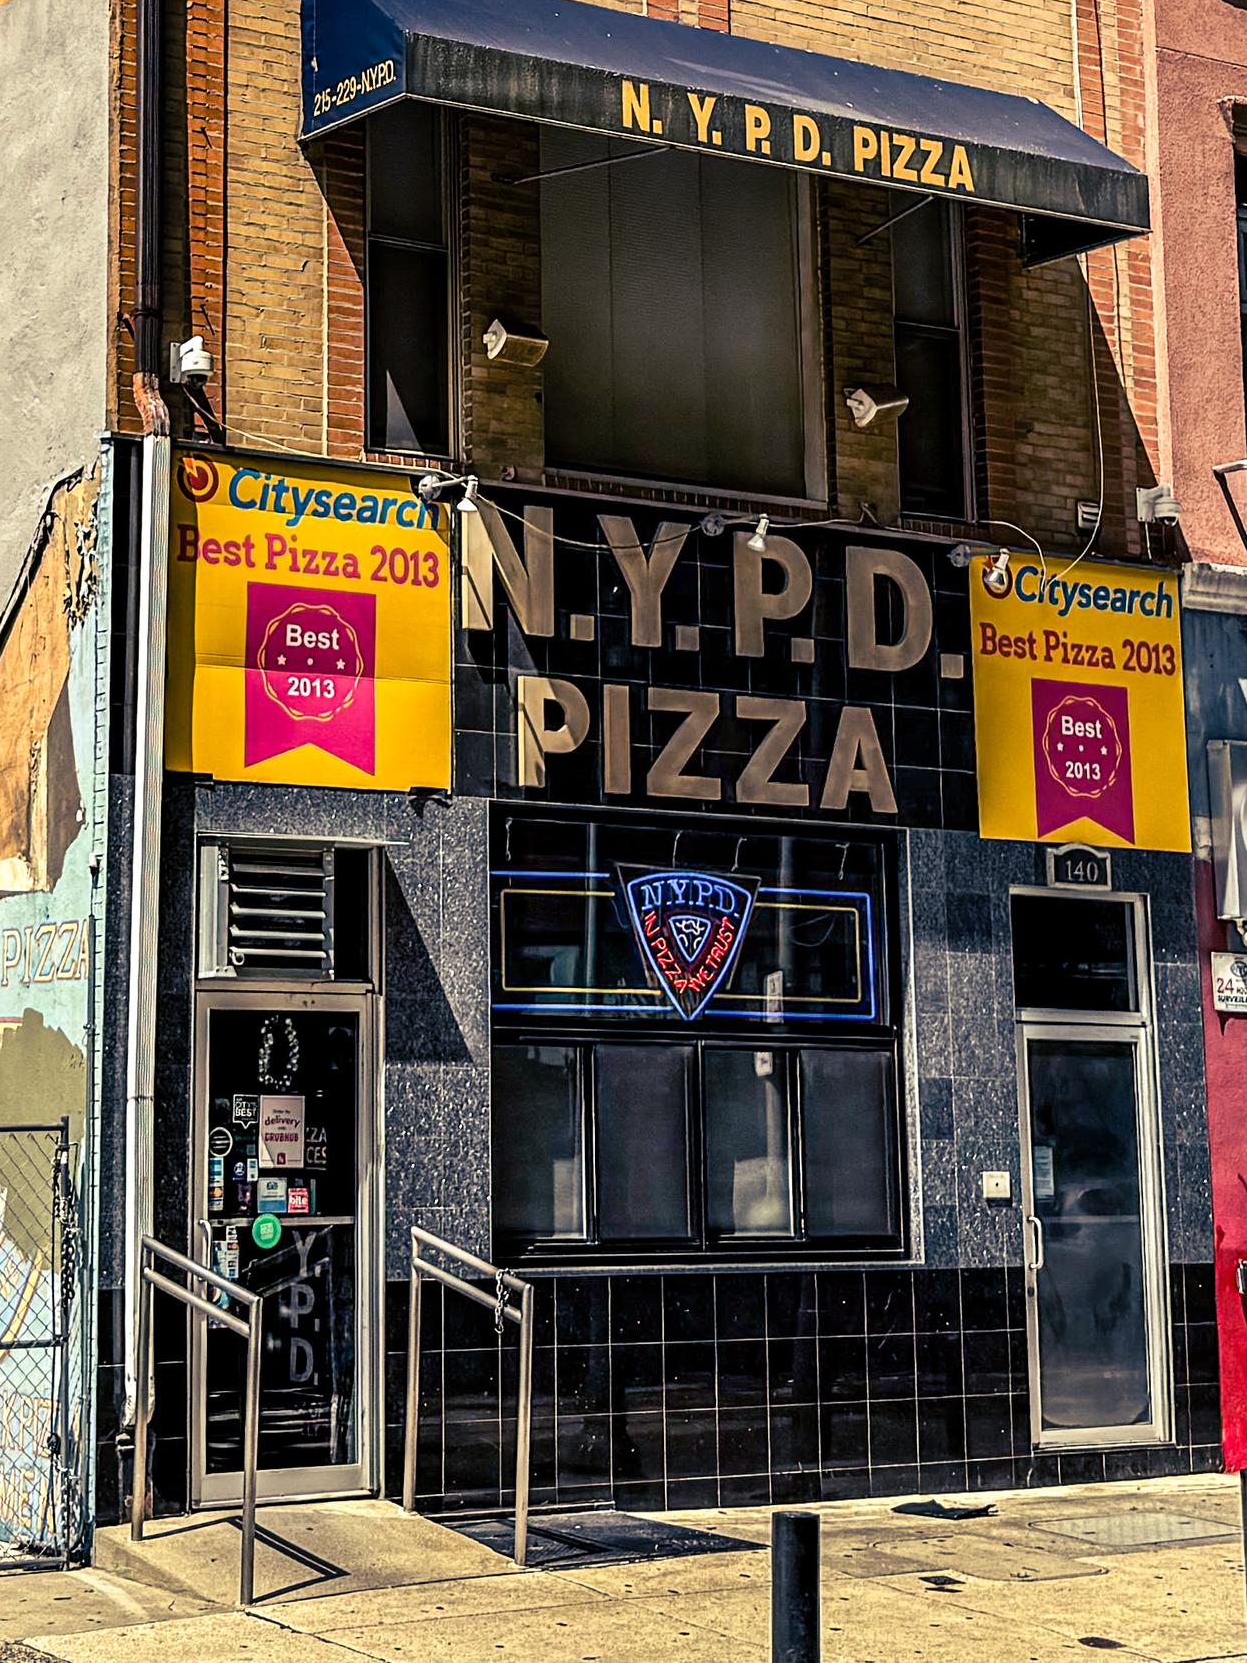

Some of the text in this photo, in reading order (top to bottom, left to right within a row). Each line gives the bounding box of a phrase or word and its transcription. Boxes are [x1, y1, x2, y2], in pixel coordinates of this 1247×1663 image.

[854, 126, 975, 193] PIZZA
[228, 467, 440, 531] Citysearch
[177, 523, 440, 588] Best Pizza 2013
[1015, 565, 1173, 618] Citysearch
[286, 624, 340, 651] Best
[979, 622, 1176, 675] Best Pizza 2013
[287, 677, 336, 699] 2013
[518, 676, 898, 813] PIZZA
[1061, 715, 1102, 739] Best
[1065, 761, 1101, 780] 2013
[1065, 859, 1099, 882] 140
[1, 919, 89, 988] PIZZA
[643, 909, 735, 994] IN PIZZA WE TRUST
[1216, 978, 1234, 994] 24
[264, 1114, 302, 1129] delivery
